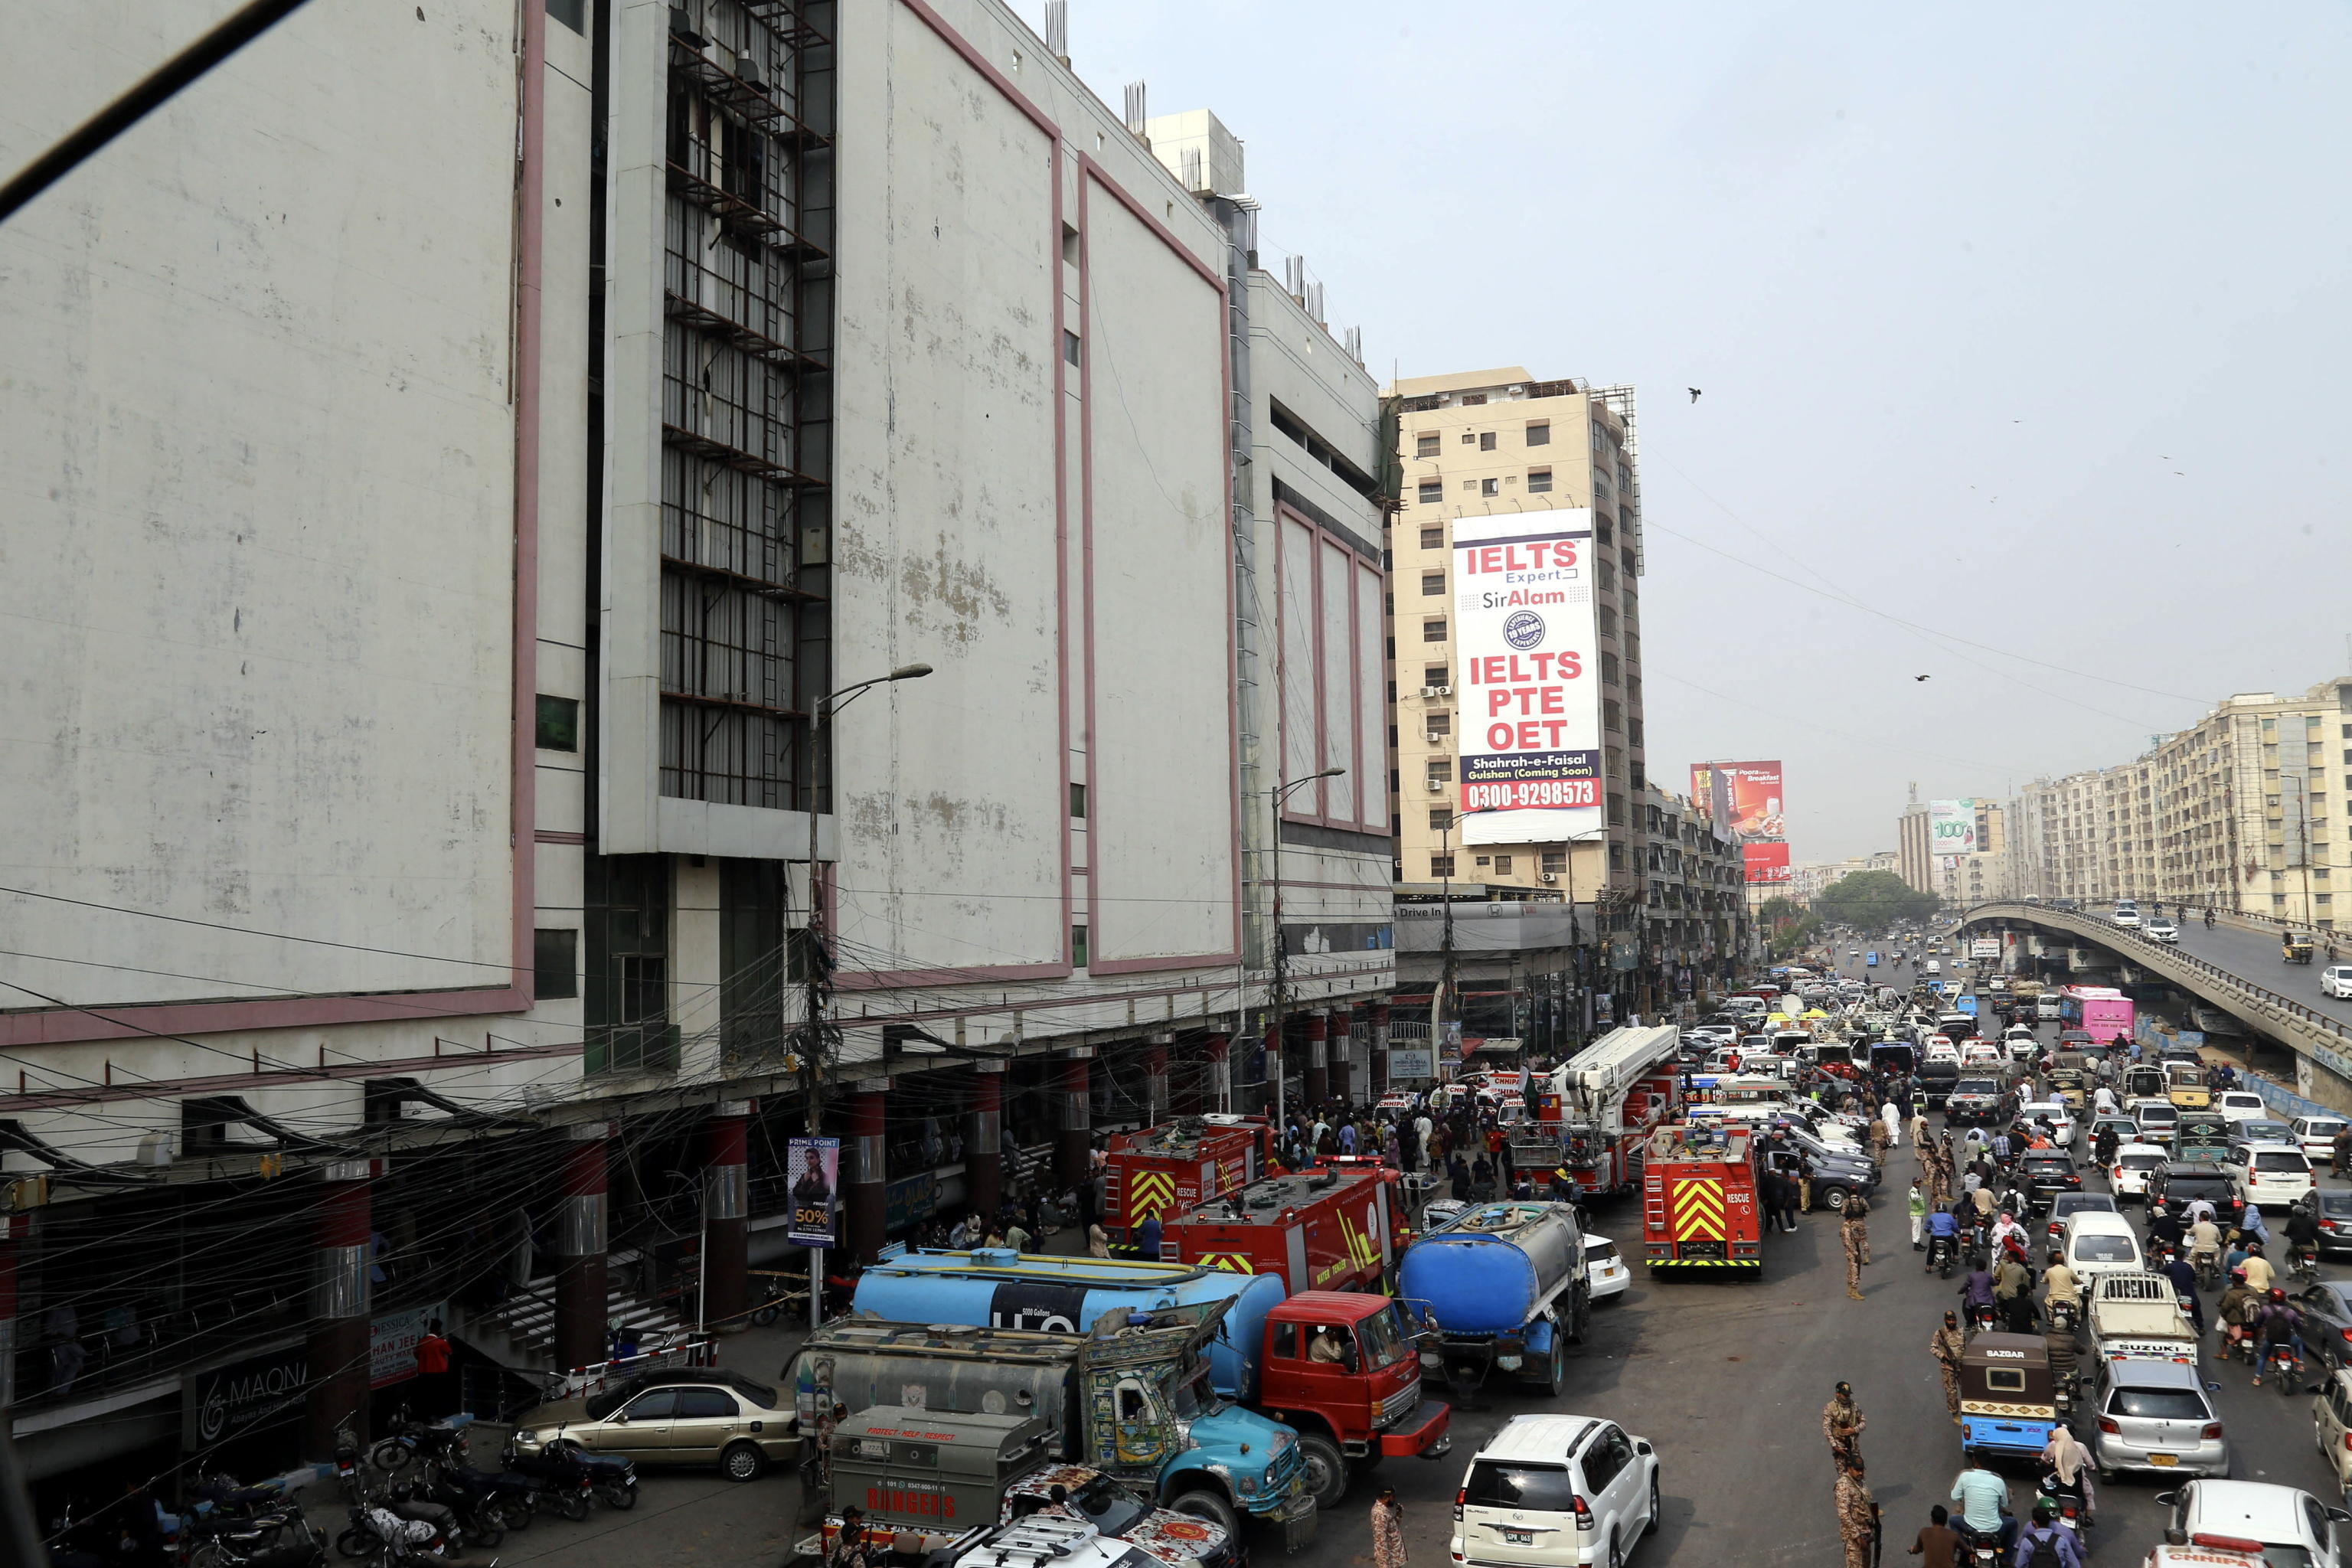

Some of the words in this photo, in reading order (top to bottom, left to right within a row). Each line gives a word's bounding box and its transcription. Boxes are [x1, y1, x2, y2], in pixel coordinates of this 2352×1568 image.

[1467, 540, 1577, 575] IELTS
[1506, 569, 1561, 585] Expert
[1508, 629, 1518, 639] 19
[1517, 621, 1541, 636] YEARS
[1470, 651, 1583, 685] IELTS
[1488, 686, 1565, 717] PTE
[1487, 720, 1568, 751] OET
[1473, 754, 1587, 769] Shahrah-e-Faisal
[1468, 769, 1512, 780] Gulshan
[1514, 766, 1559, 779] (Coming
[1560, 766, 1592, 778] Soon)
[1468, 782, 1595, 808] 0300-9298573
[1400, 908, 1428, 917] Drive
[1432, 907, 1441, 916] In
[1177, 1187, 1197, 1197] RESCUE
[1726, 1193, 1750, 1204] RESCUE
[795, 1209, 828, 1224] 50%
[1317, 1268, 1331, 1286] WATER
[1331, 1258, 1347, 1276] TENDER
[1023, 1308, 1033, 1316] 5000
[1034, 1308, 1050, 1317] Gallons
[373, 1341, 394, 1357] HAN
[1986, 1350, 2025, 1359] SAZGAR
[2119, 1344, 2180, 1352] SUZUKI
[867, 1427, 899, 1436] PROTECT
[923, 1432, 956, 1441] RESPECT
[866, 1488, 956, 1518] RANGERS
[2168, 1553, 2252, 1568] CHHIPA
